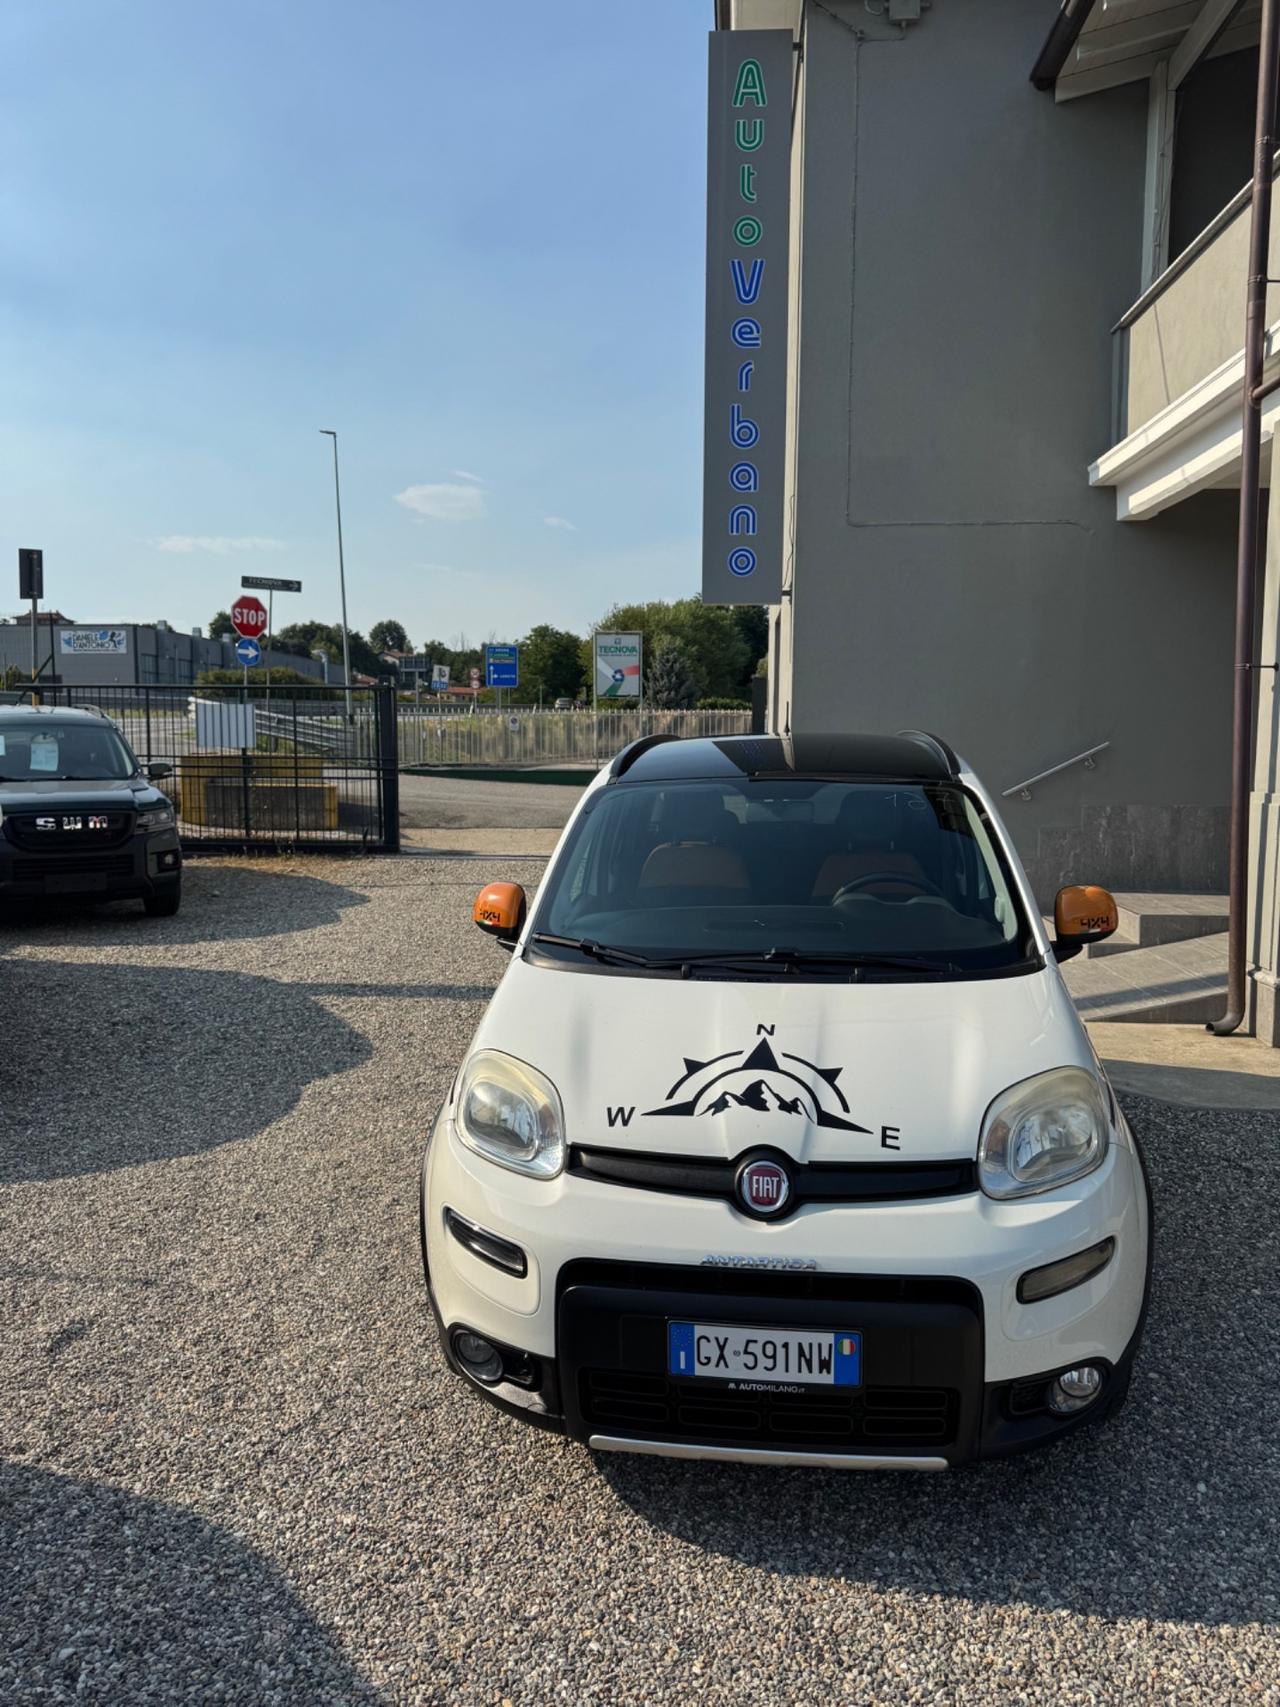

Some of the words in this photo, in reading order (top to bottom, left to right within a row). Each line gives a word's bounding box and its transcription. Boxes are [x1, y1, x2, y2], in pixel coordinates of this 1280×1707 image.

[234, 608, 266, 626] STOP
[599, 646, 638, 654] TECNOVA
[756, 1024, 775, 1036] N
[606, 1106, 636, 1127] W
[881, 1126, 901, 1150] E
[751, 1175, 780, 1198] FIAT
[696, 1335, 730, 1369] GX
[743, 1339, 833, 1375] 591NW
